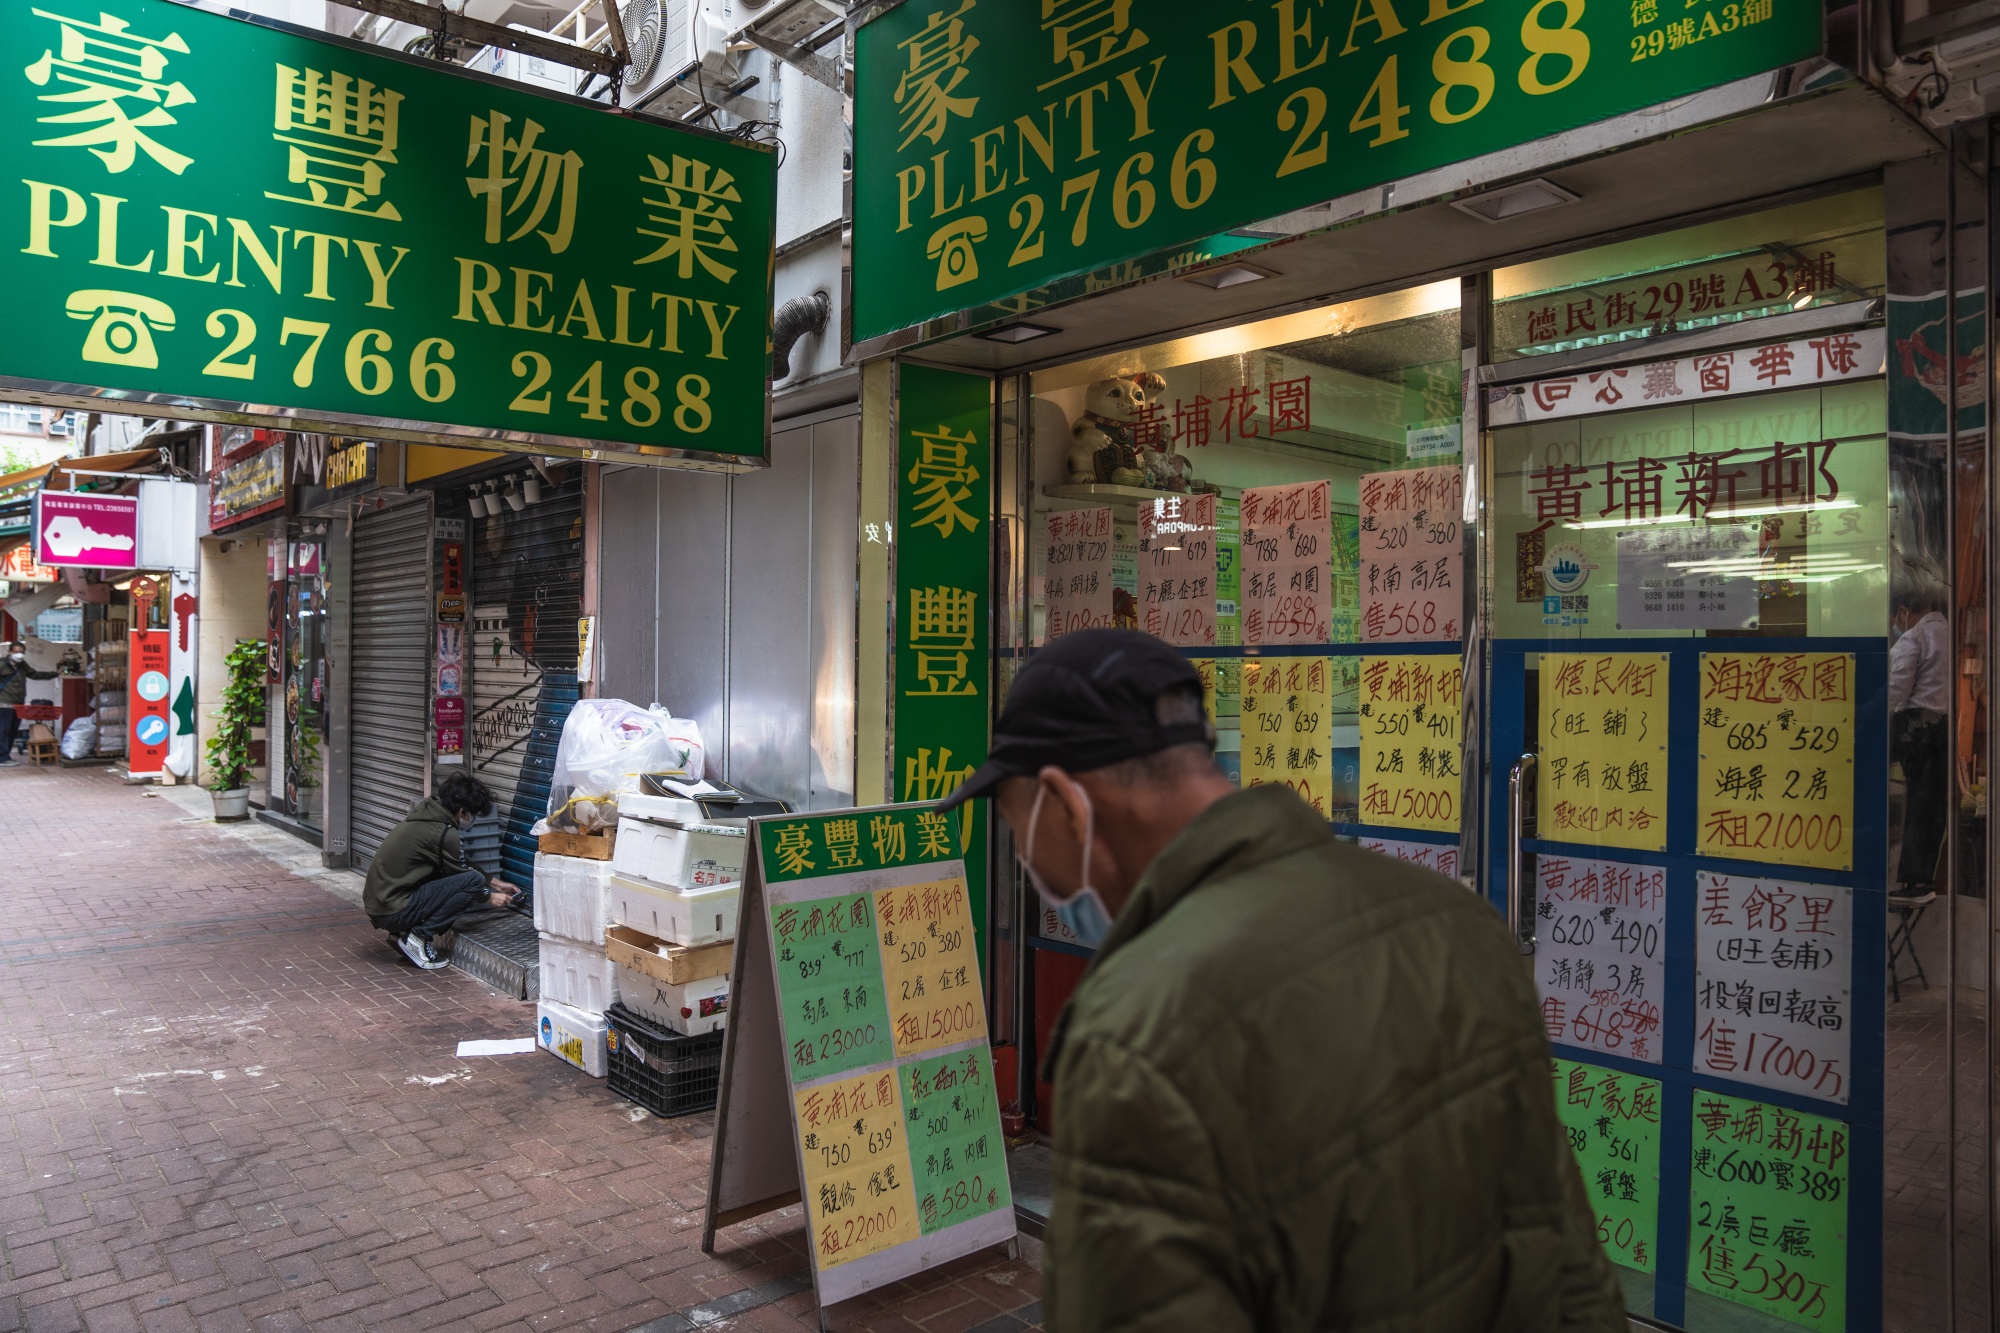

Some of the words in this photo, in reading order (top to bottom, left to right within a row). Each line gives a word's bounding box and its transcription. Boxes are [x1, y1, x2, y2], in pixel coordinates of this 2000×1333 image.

[25, 7, 742, 284] 豪豐物業
[895, 55, 1167, 233] PLENTY
[1008, 128, 1217, 268] 2766
[1276, 0, 1590, 179] 2488
[20, 178, 410, 310] PLENTY
[452, 256, 740, 361] REALTY
[202, 308, 456, 403] 2766
[508, 350, 713, 433] 2488
[774, 810, 951, 875] 豪豐物業
